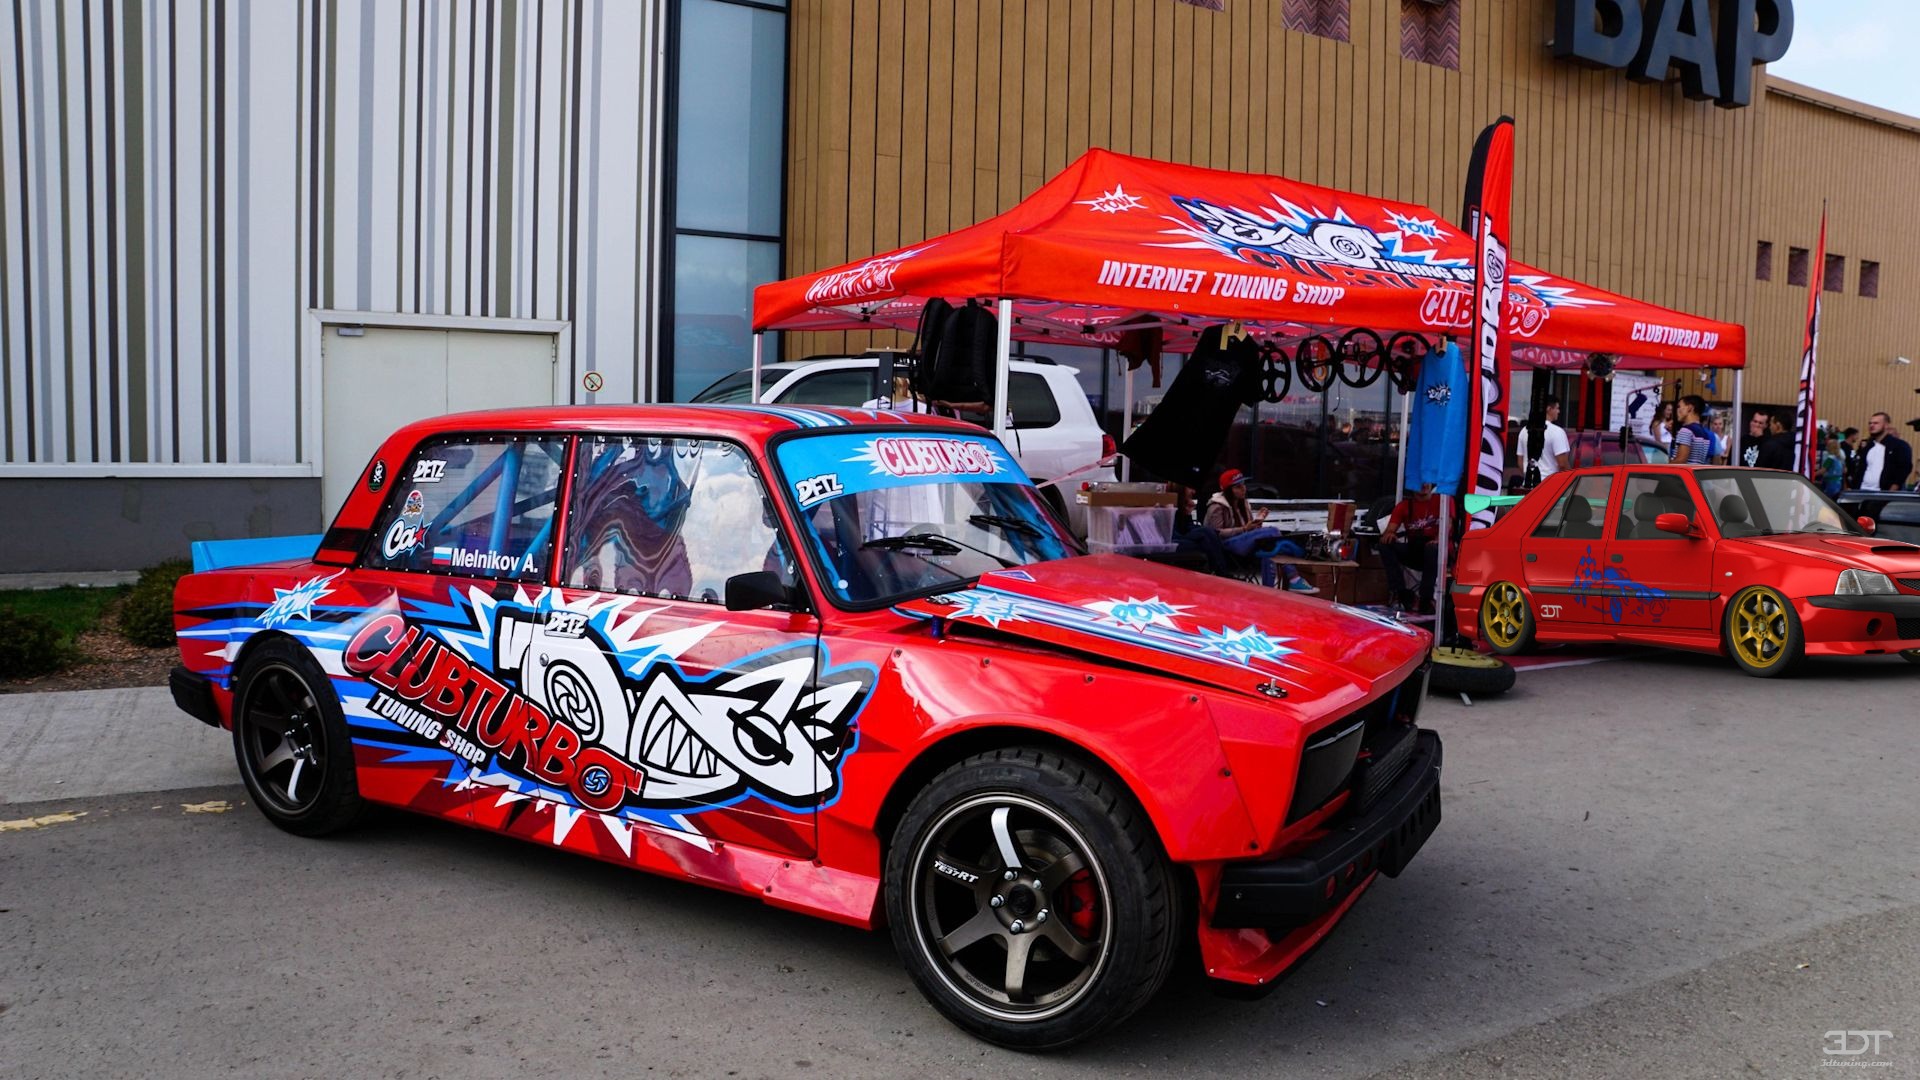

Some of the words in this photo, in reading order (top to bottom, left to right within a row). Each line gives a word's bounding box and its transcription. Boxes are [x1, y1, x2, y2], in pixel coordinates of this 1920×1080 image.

[1396, 214, 1436, 237] POW
[1098, 260, 1207, 294] INTERNET
[1210, 271, 1287, 302] TUNING
[1292, 282, 1346, 306] SHOP
[1376, 258, 1450, 280] TUNING
[1631, 321, 1719, 350] CLUBTURBO.RU
[876, 438, 995, 476] CLUBTURBO
[452, 547, 521, 571] Melnikov
[522, 552, 539, 573] A.
[344, 614, 643, 812] CLUBTURBO
[373, 692, 440, 742] TUNING
[439, 728, 487, 765] SHOP
